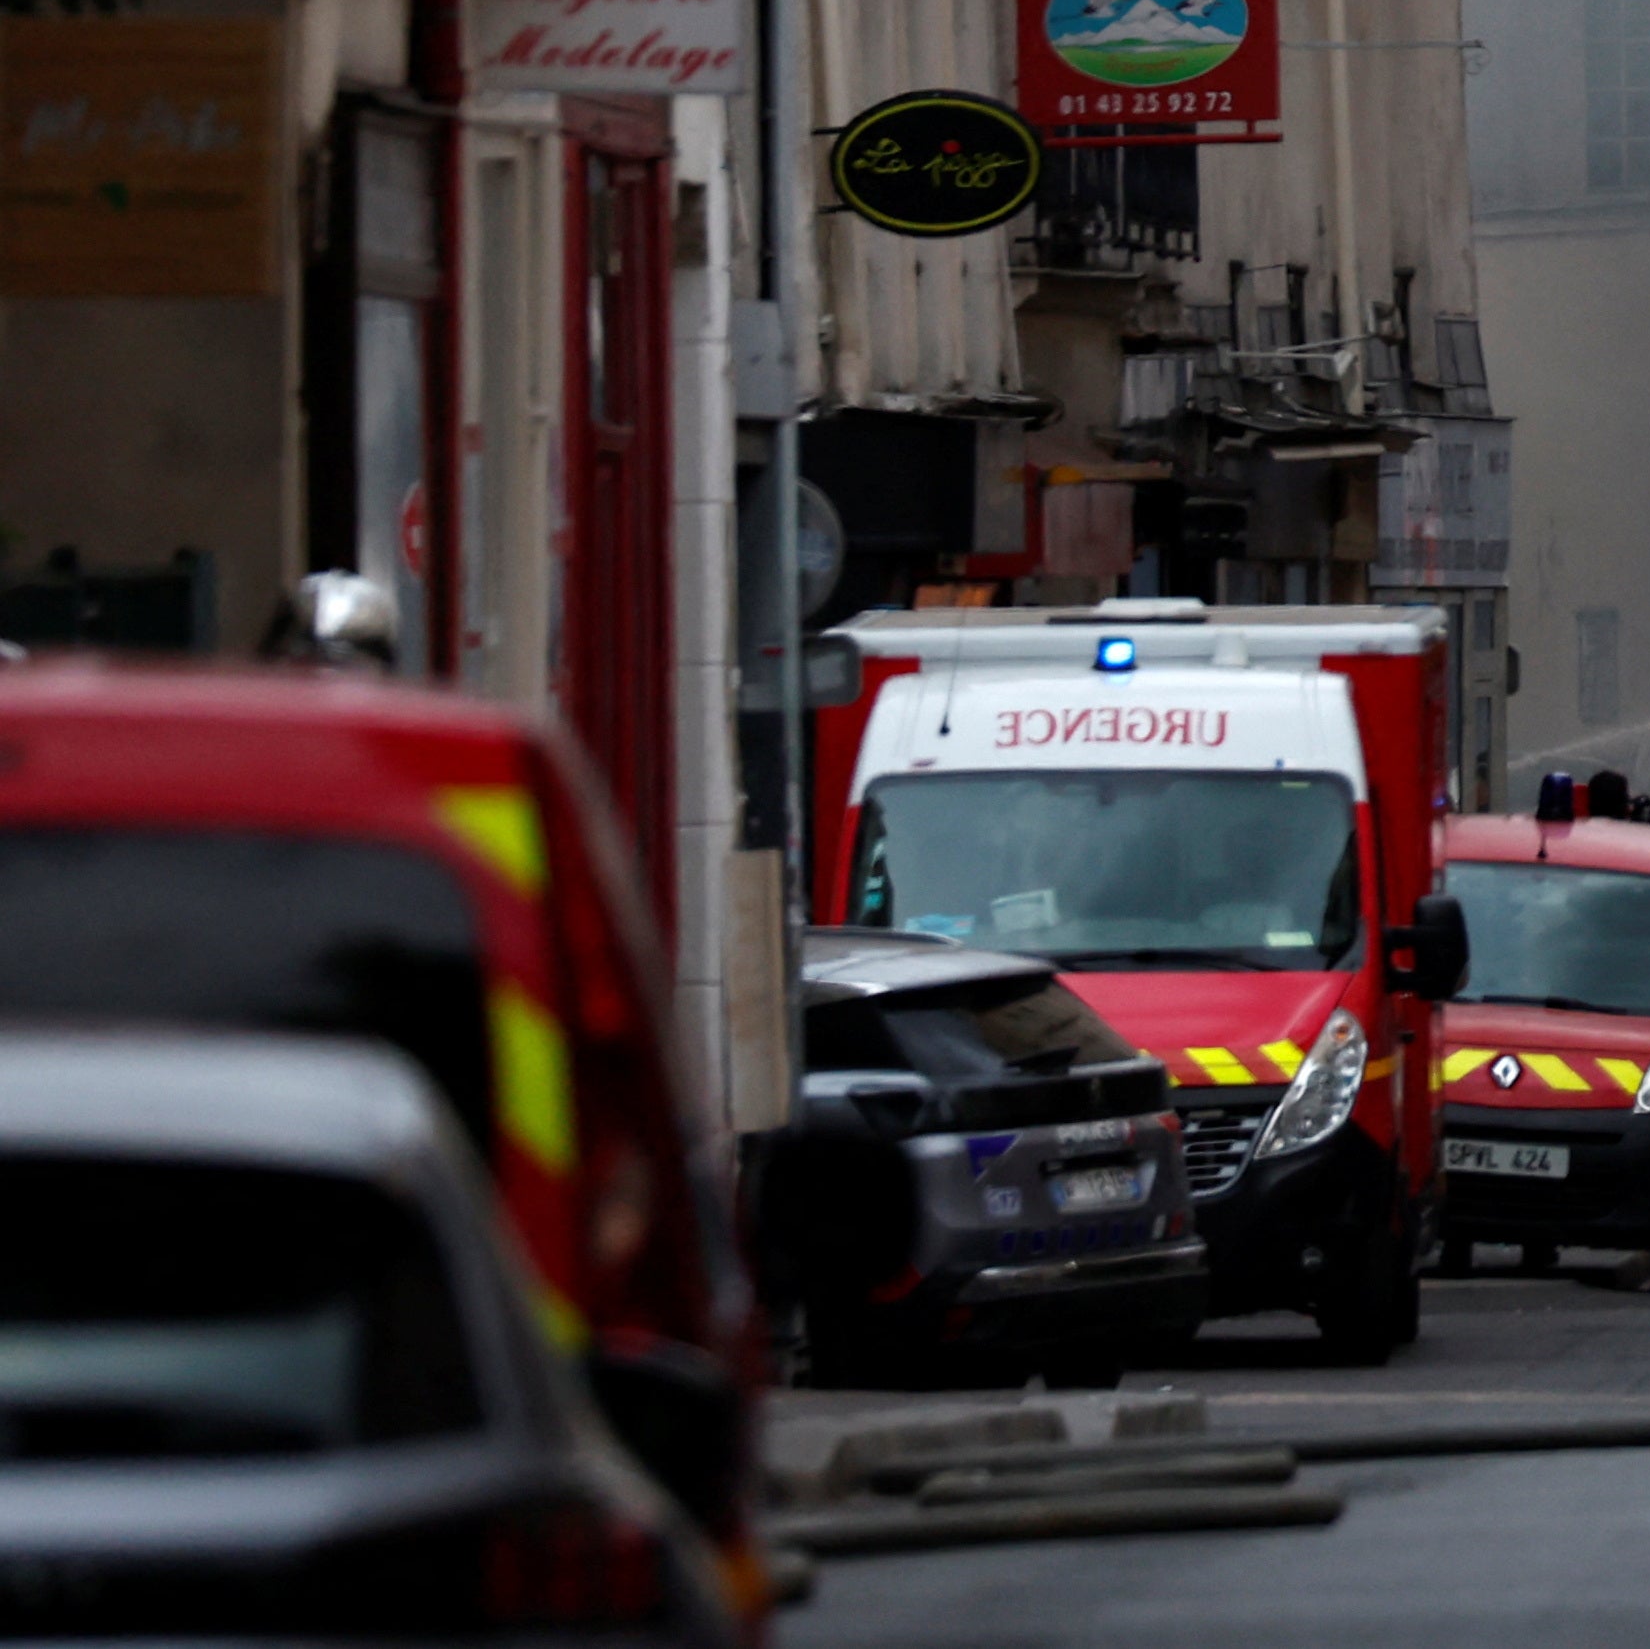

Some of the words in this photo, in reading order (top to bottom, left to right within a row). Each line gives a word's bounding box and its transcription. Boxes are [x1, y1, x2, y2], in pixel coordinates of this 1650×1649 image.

[482, 24, 737, 85] Modelage
[1060, 94, 1086, 115] 01
[1097, 94, 1124, 114] 43
[1132, 93, 1160, 114] 25
[1168, 92, 1197, 113] 92
[1206, 91, 1233, 112] 72
